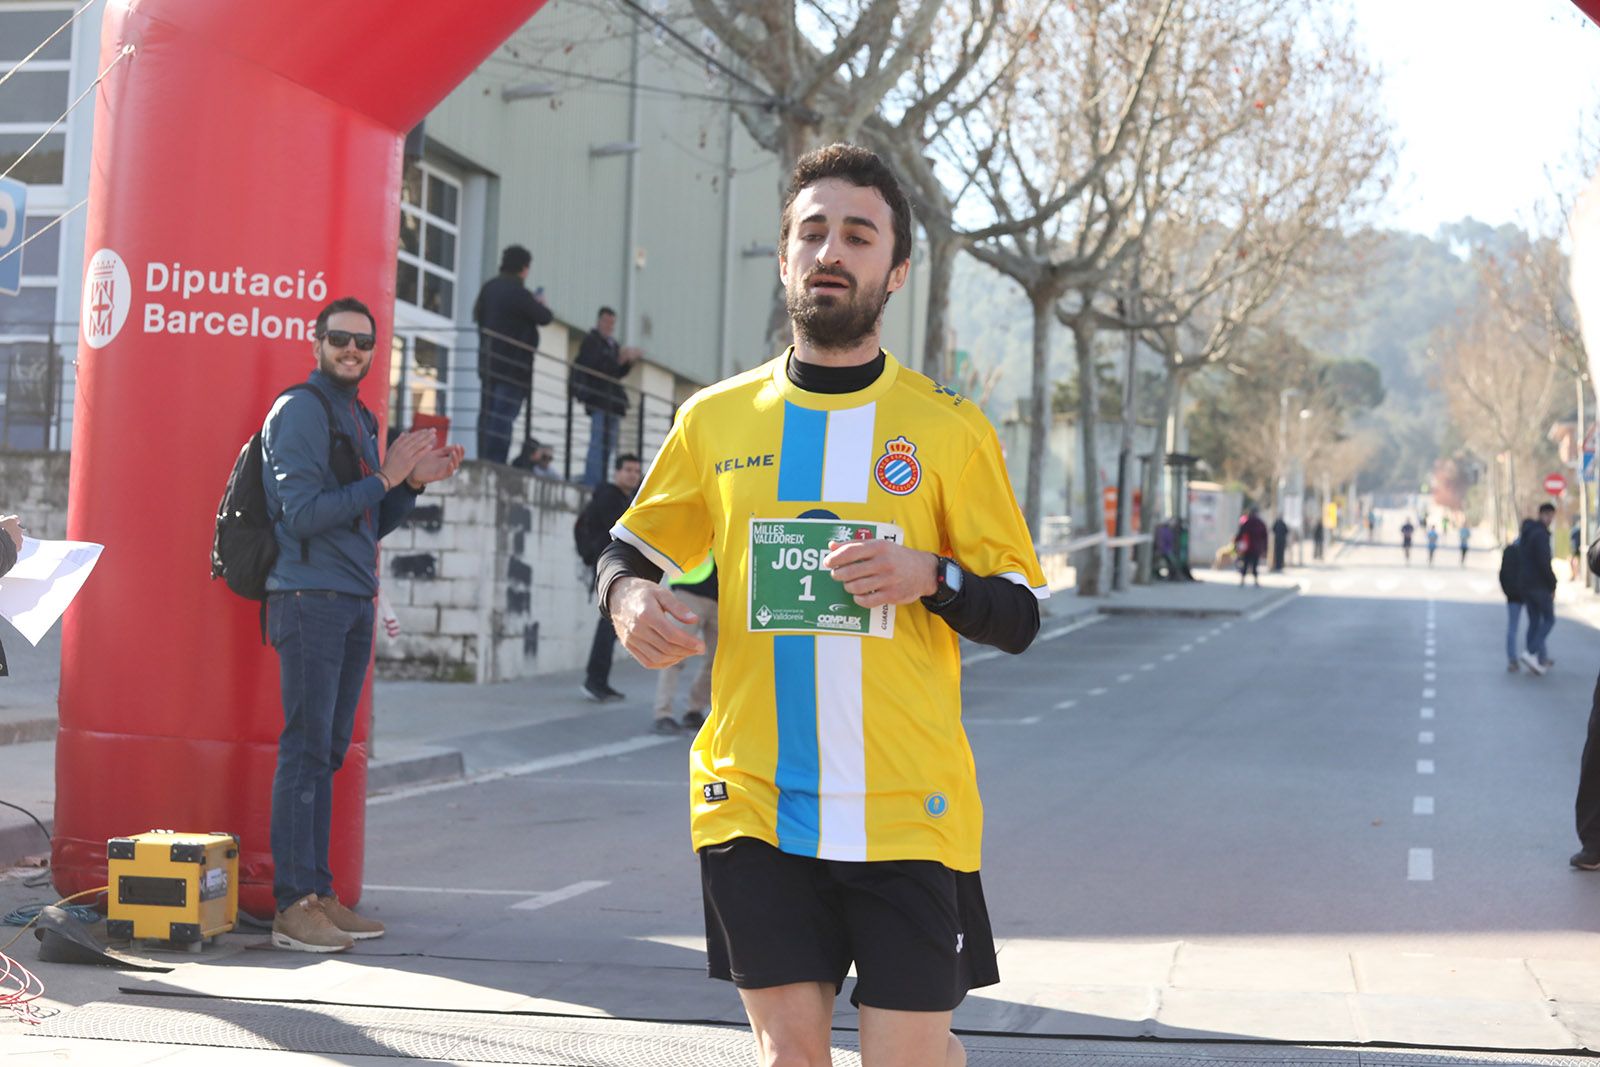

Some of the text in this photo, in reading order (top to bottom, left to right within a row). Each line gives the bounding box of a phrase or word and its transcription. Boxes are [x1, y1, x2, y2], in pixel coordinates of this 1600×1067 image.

[146, 262, 328, 302] Diputació
[715, 454, 775, 475] KELME
[754, 524, 785, 535] MILLES
[754, 534, 805, 544] VALLDOREIX
[798, 575, 816, 602] 1
[817, 614, 862, 625] COMPLEX
